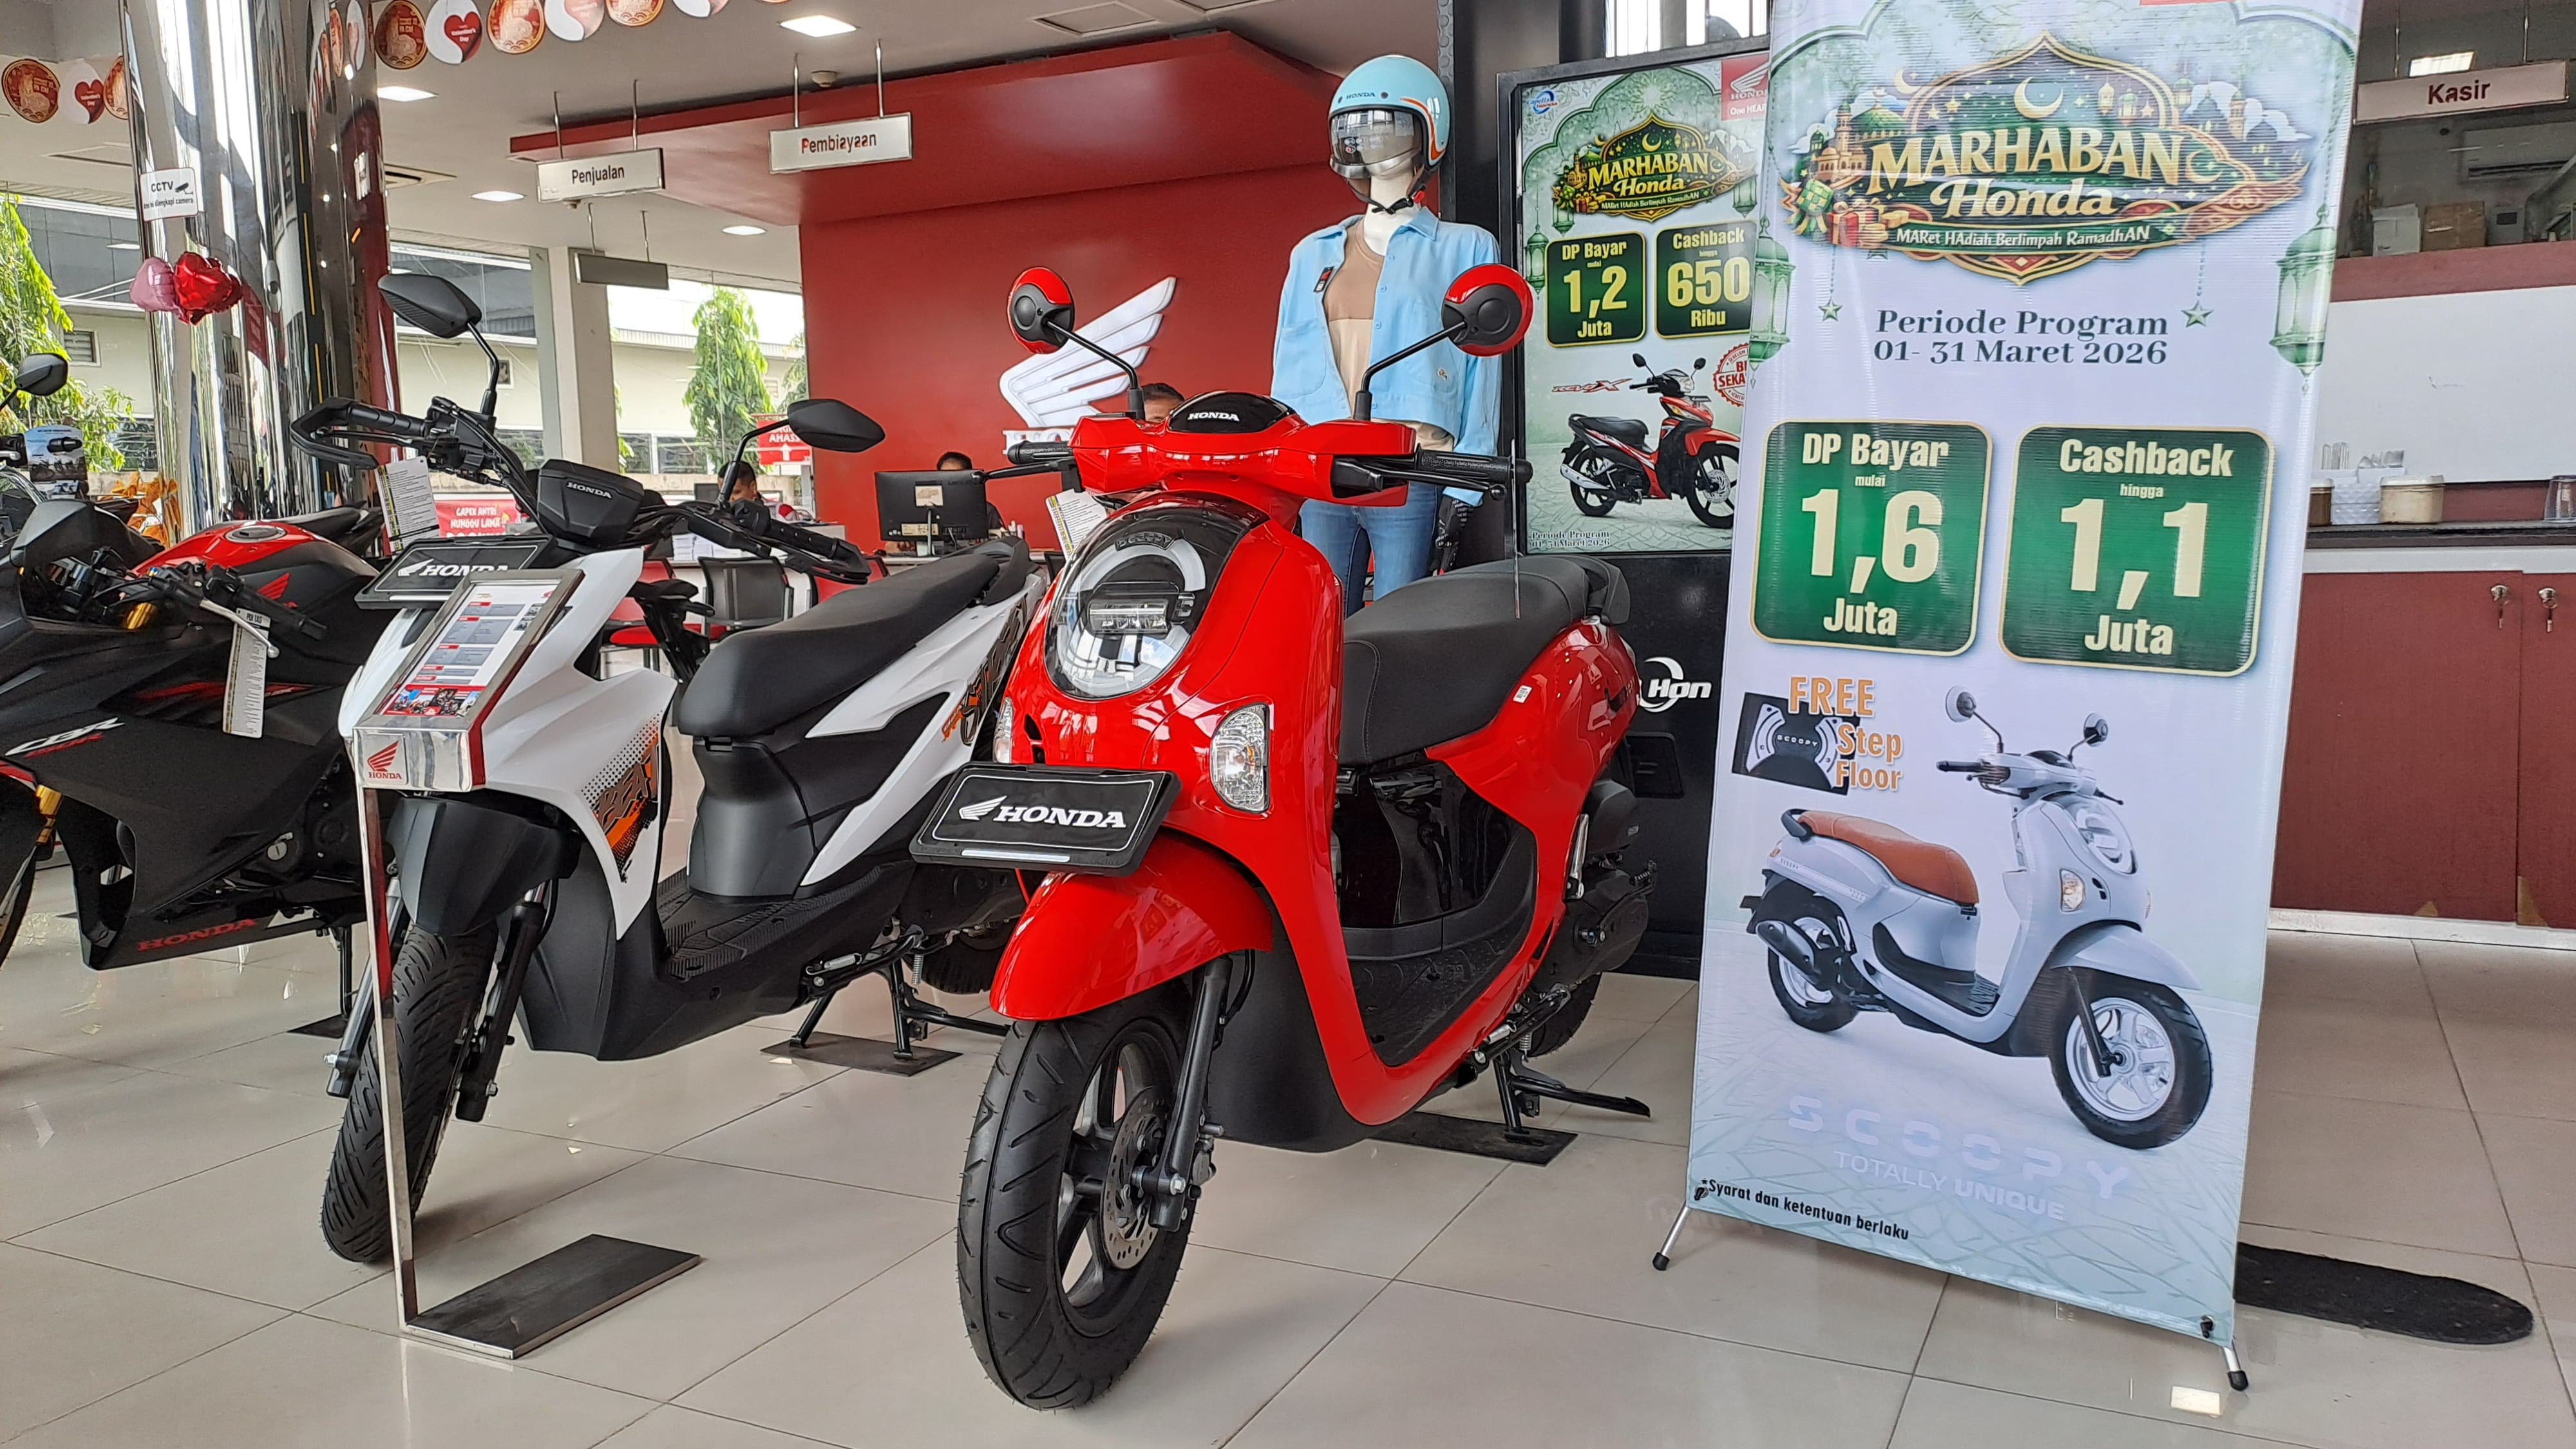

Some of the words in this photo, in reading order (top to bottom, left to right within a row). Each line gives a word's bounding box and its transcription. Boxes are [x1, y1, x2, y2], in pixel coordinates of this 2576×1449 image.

[1730, 90, 1766, 100] HOND
[2428, 79, 2490, 104] Kasir
[801, 133, 876, 154] Pembiayaan
[1588, 153, 1709, 190] MARHABAN
[1867, 127, 2186, 194] MARHABAN
[151, 180, 173, 193] CCTV
[572, 165, 625, 185] Penjualan
[1613, 175, 1686, 196] Honda
[1929, 178, 2118, 219] Honda
[1672, 227, 1745, 251] Cashback
[1896, 227, 1940, 245] MARet
[1945, 229, 1992, 246] HAdiah
[1996, 230, 2062, 249] Berlimpah
[2067, 225, 2151, 246] RamadhAN
[1562, 245, 1580, 261] DP
[1584, 241, 1627, 258] Bayar
[1563, 265, 1627, 319] 1,2
[1667, 257, 1750, 307] 650
[1577, 320, 1612, 338] Juta
[1690, 309, 1727, 327] Ribu
[1875, 309, 2006, 334] Periode
[2014, 310, 2168, 342] Program
[1930, 341, 1965, 364] 31
[1974, 339, 2075, 364] Maret
[2083, 340, 2167, 364] 2026
[1188, 412, 1240, 422] HONDA
[1802, 433, 1841, 464] DP
[1851, 433, 1949, 471] Bayar
[2060, 439, 2235, 477] Cashback
[566, 481, 612, 499] HONDA
[1855, 475, 1886, 488] mulai
[2119, 483, 2164, 499] hingga
[1532, 530, 1567, 539] Periode
[1569, 529, 1609, 539] Program
[1587, 538, 1610, 547] 2026
[1802, 489, 1942, 594] 1,6
[2061, 498, 2209, 611] 1,1
[1823, 597, 1898, 636] Juta
[2084, 614, 2174, 655] Juta
[1789, 676, 1873, 715] FREE
[1837, 724, 1902, 763] Step
[368, 772, 402, 780] HONDA
[1835, 761, 1900, 790] Floor
[993, 806, 1126, 828] HONDA
[137, 918, 256, 951] HONDA
[1788, 1095, 2130, 1199] SCOOPY
[1834, 1150, 1949, 1191] TOTALLY
[1953, 1178, 2065, 1222] UNIQUE
[1755, 1190, 1779, 1208] dan
[1783, 1197, 1852, 1226] ketentuan
[1857, 1214, 1909, 1240] berlaku
